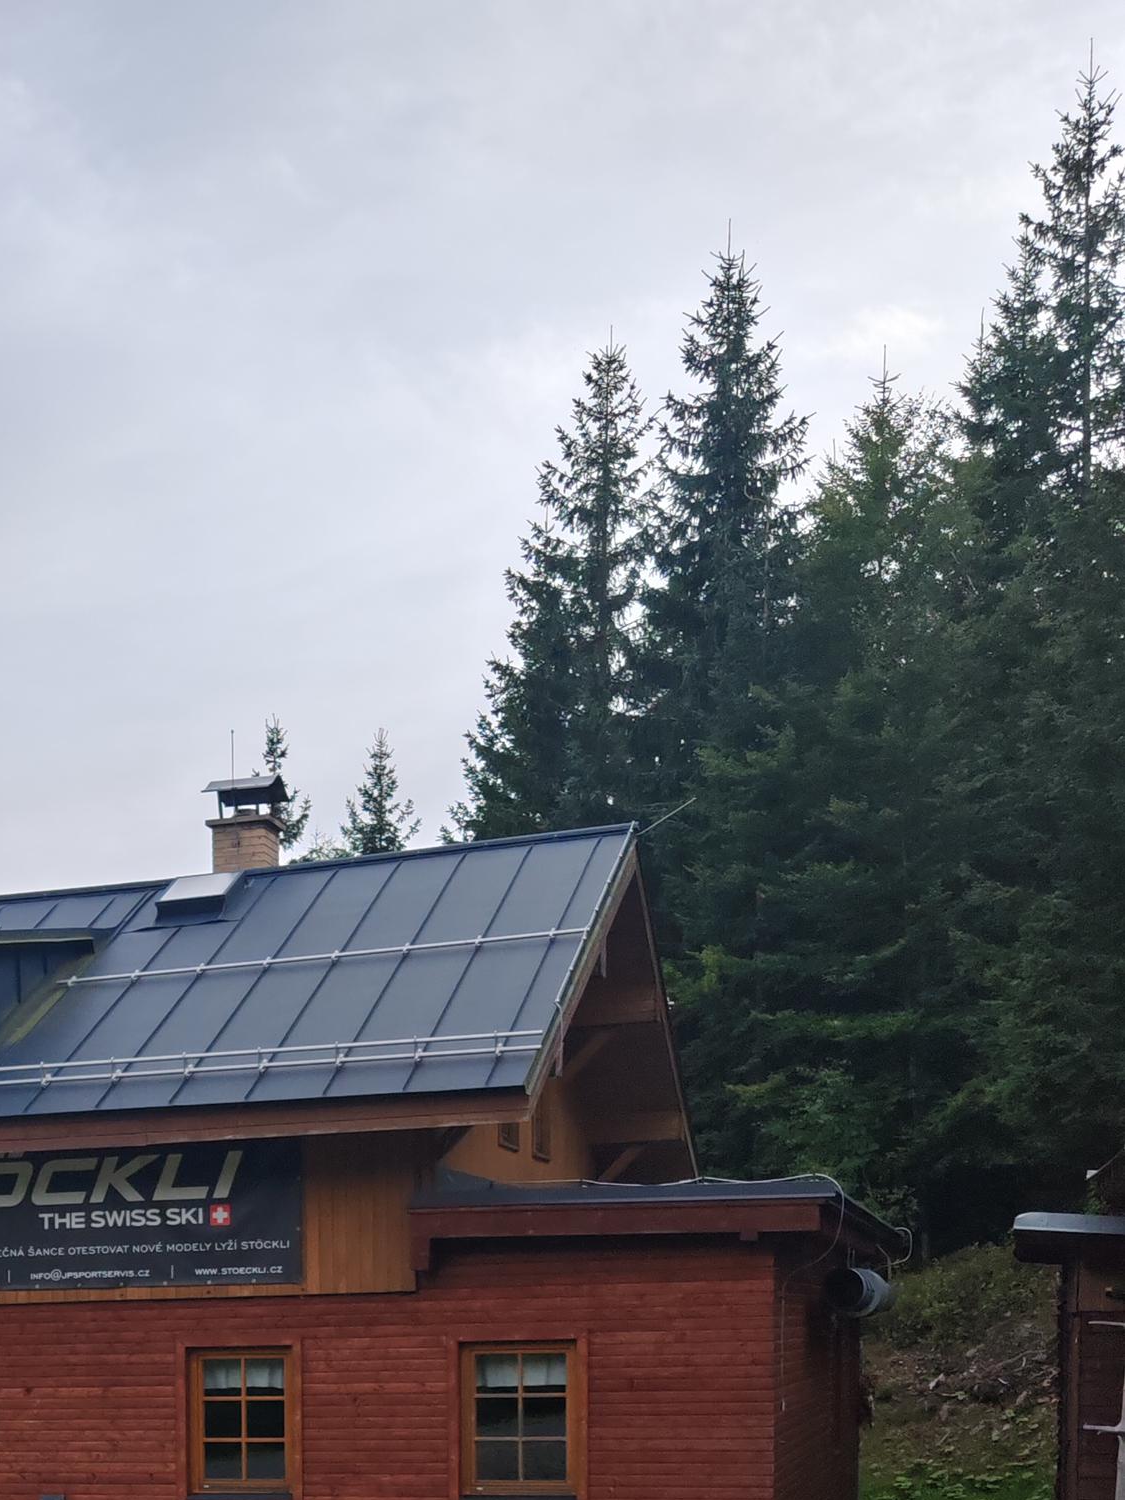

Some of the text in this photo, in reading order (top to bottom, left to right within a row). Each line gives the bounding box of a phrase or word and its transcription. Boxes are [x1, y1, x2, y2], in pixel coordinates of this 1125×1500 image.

[38, 1207, 204, 1230] THE SWISS SKI
[27, 1246, 65, 1257] ŠANCE
[67, 1244, 130, 1255] OTESTOVAT
[132, 1242, 163, 1253] NOVÉ
[166, 1242, 212, 1252] MODELY
[214, 1239, 238, 1251] LYŽÍ
[241, 1239, 290, 1250] STÖCKLI
